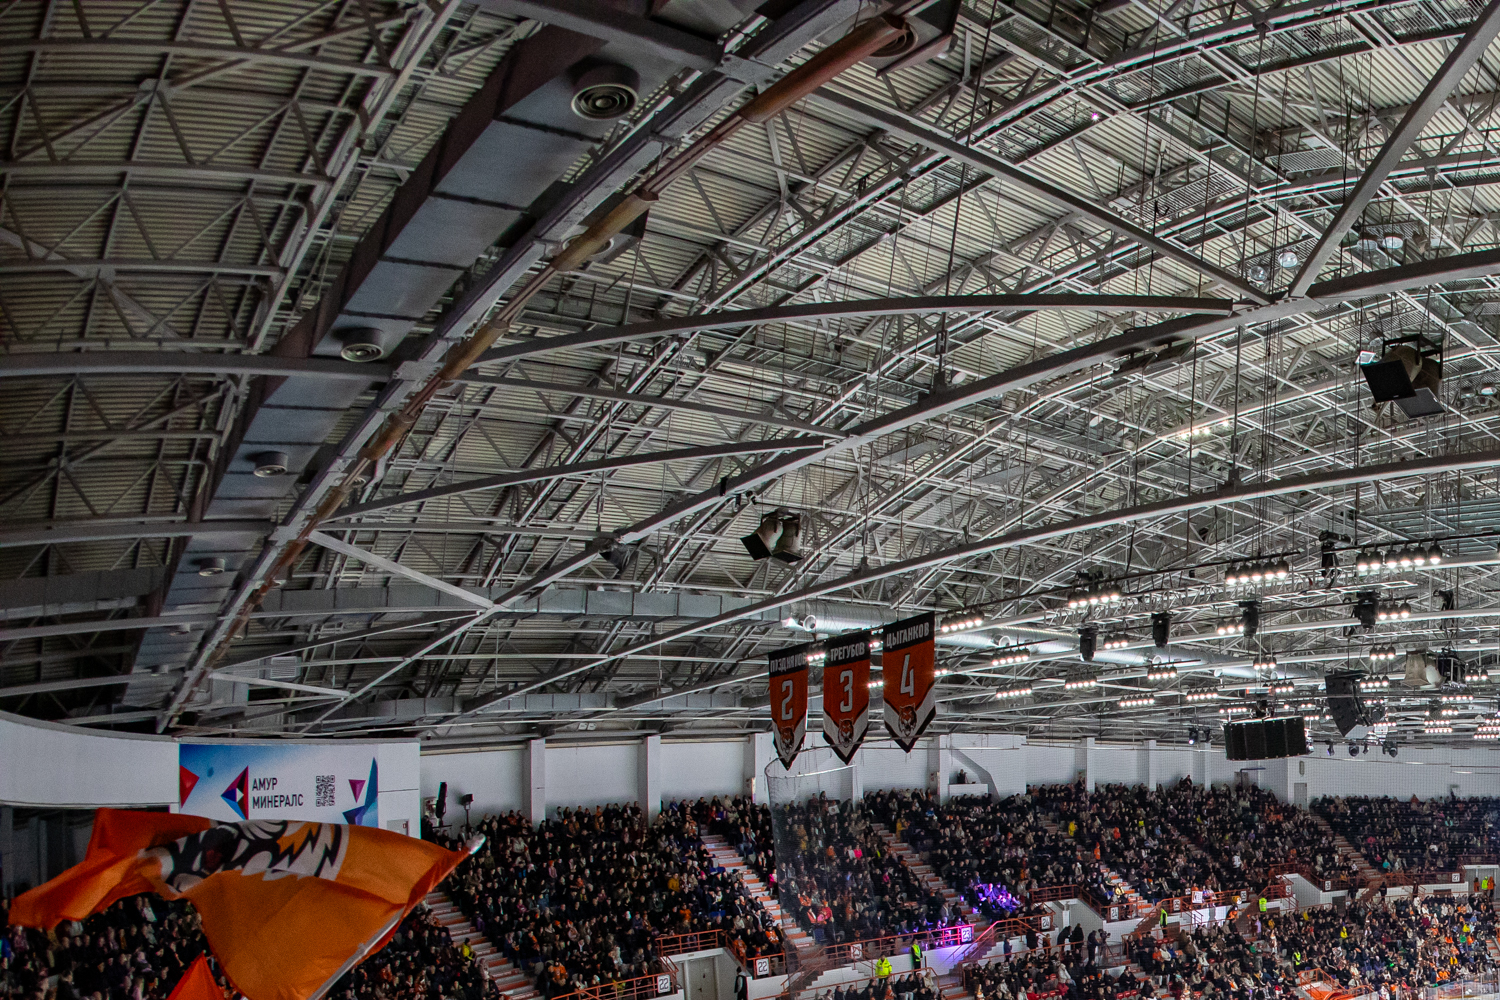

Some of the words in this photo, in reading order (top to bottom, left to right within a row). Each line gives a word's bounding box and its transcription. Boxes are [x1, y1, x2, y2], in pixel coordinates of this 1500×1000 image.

[886, 621, 930, 648] ЦЫГАНКОВ
[830, 642, 865, 661] ТРЕГУБОВ
[900, 654, 914, 697] 4
[781, 679, 793, 720] 2
[840, 669, 853, 712] 3
[252, 777, 278, 791] АМУР
[252, 793, 304, 810] МИНЕРАЛС
[758, 961, 768, 973] 22
[659, 977, 670, 991] 22
